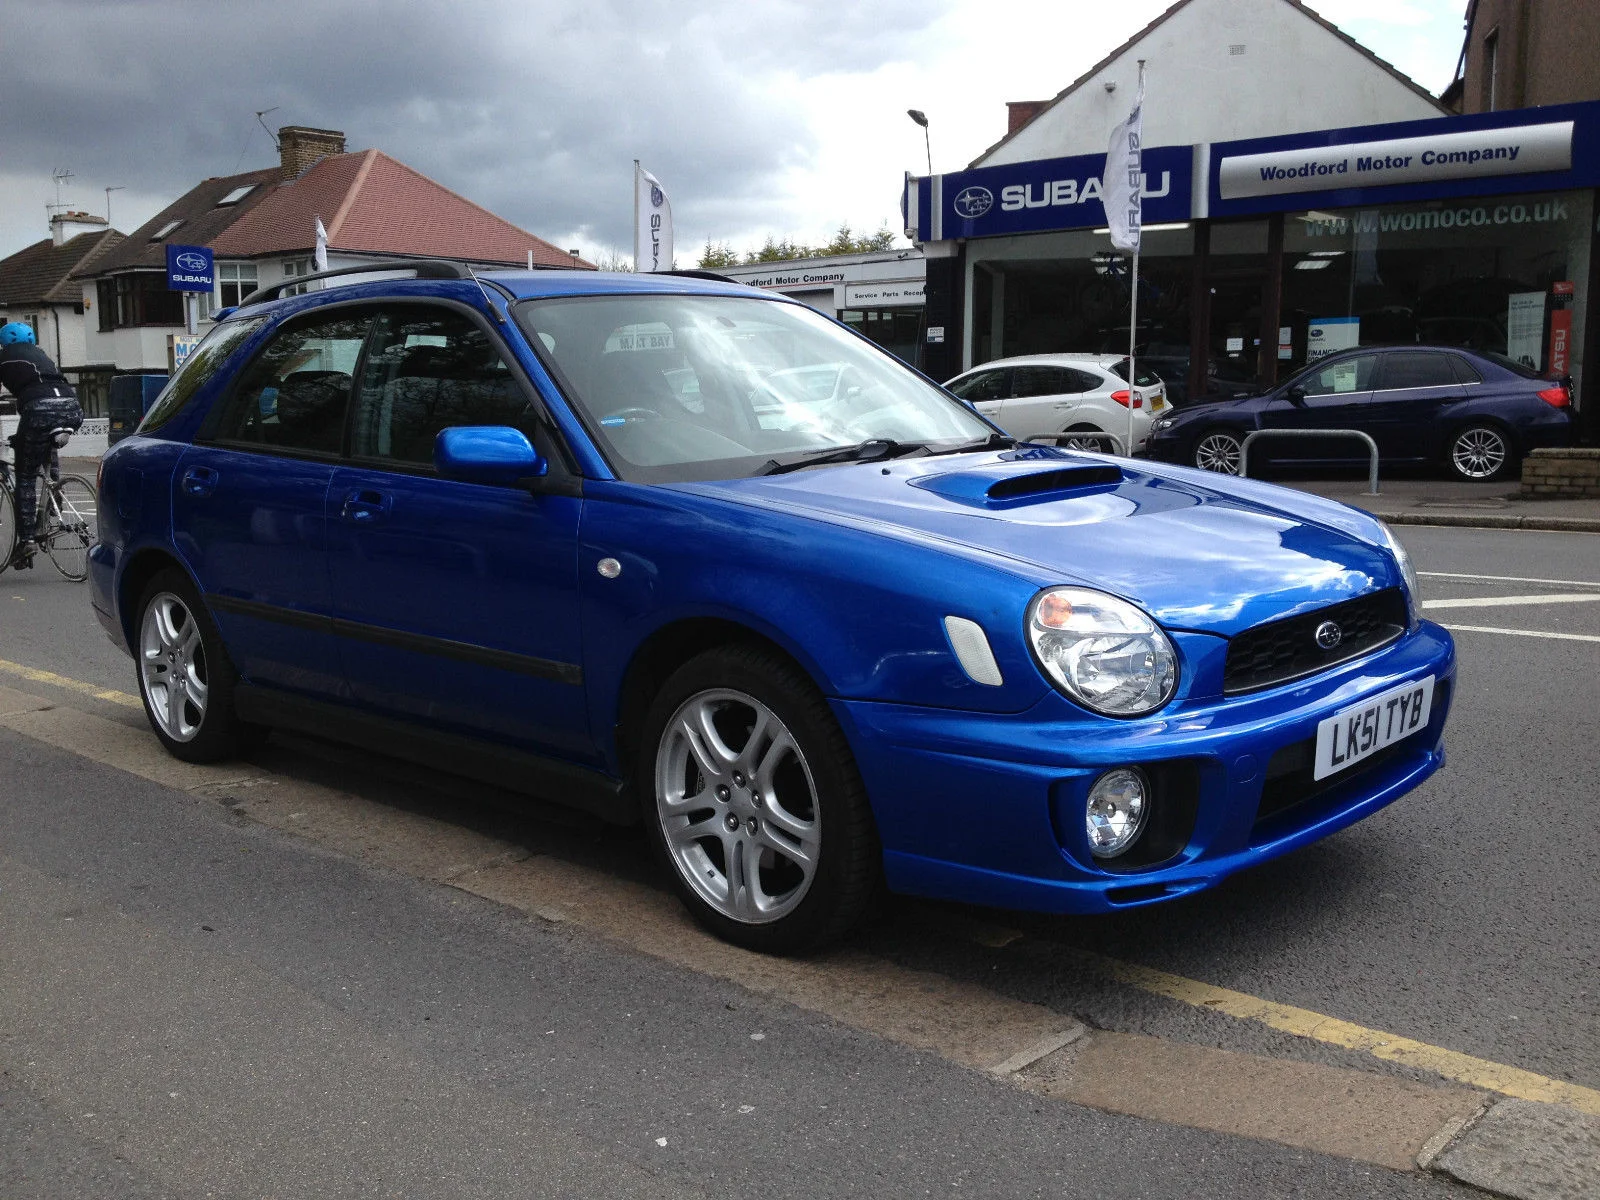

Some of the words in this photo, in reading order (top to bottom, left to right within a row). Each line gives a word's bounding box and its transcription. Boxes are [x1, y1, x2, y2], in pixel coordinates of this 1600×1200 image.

[1260, 159, 1348, 182] Woodford
[1356, 154, 1413, 173] Motor
[1421, 146, 1521, 167] Company
[1001, 171, 1170, 211] SUBAU
[1305, 199, 1568, 237] www.womoco.co.uk
[172, 274, 212, 284] SUBARU
[742, 277, 772, 287] odford
[775, 276, 800, 285] Motor
[803, 273, 845, 283] Company
[1331, 706, 1380, 766] LK51
[1386, 688, 1424, 740] TYB
